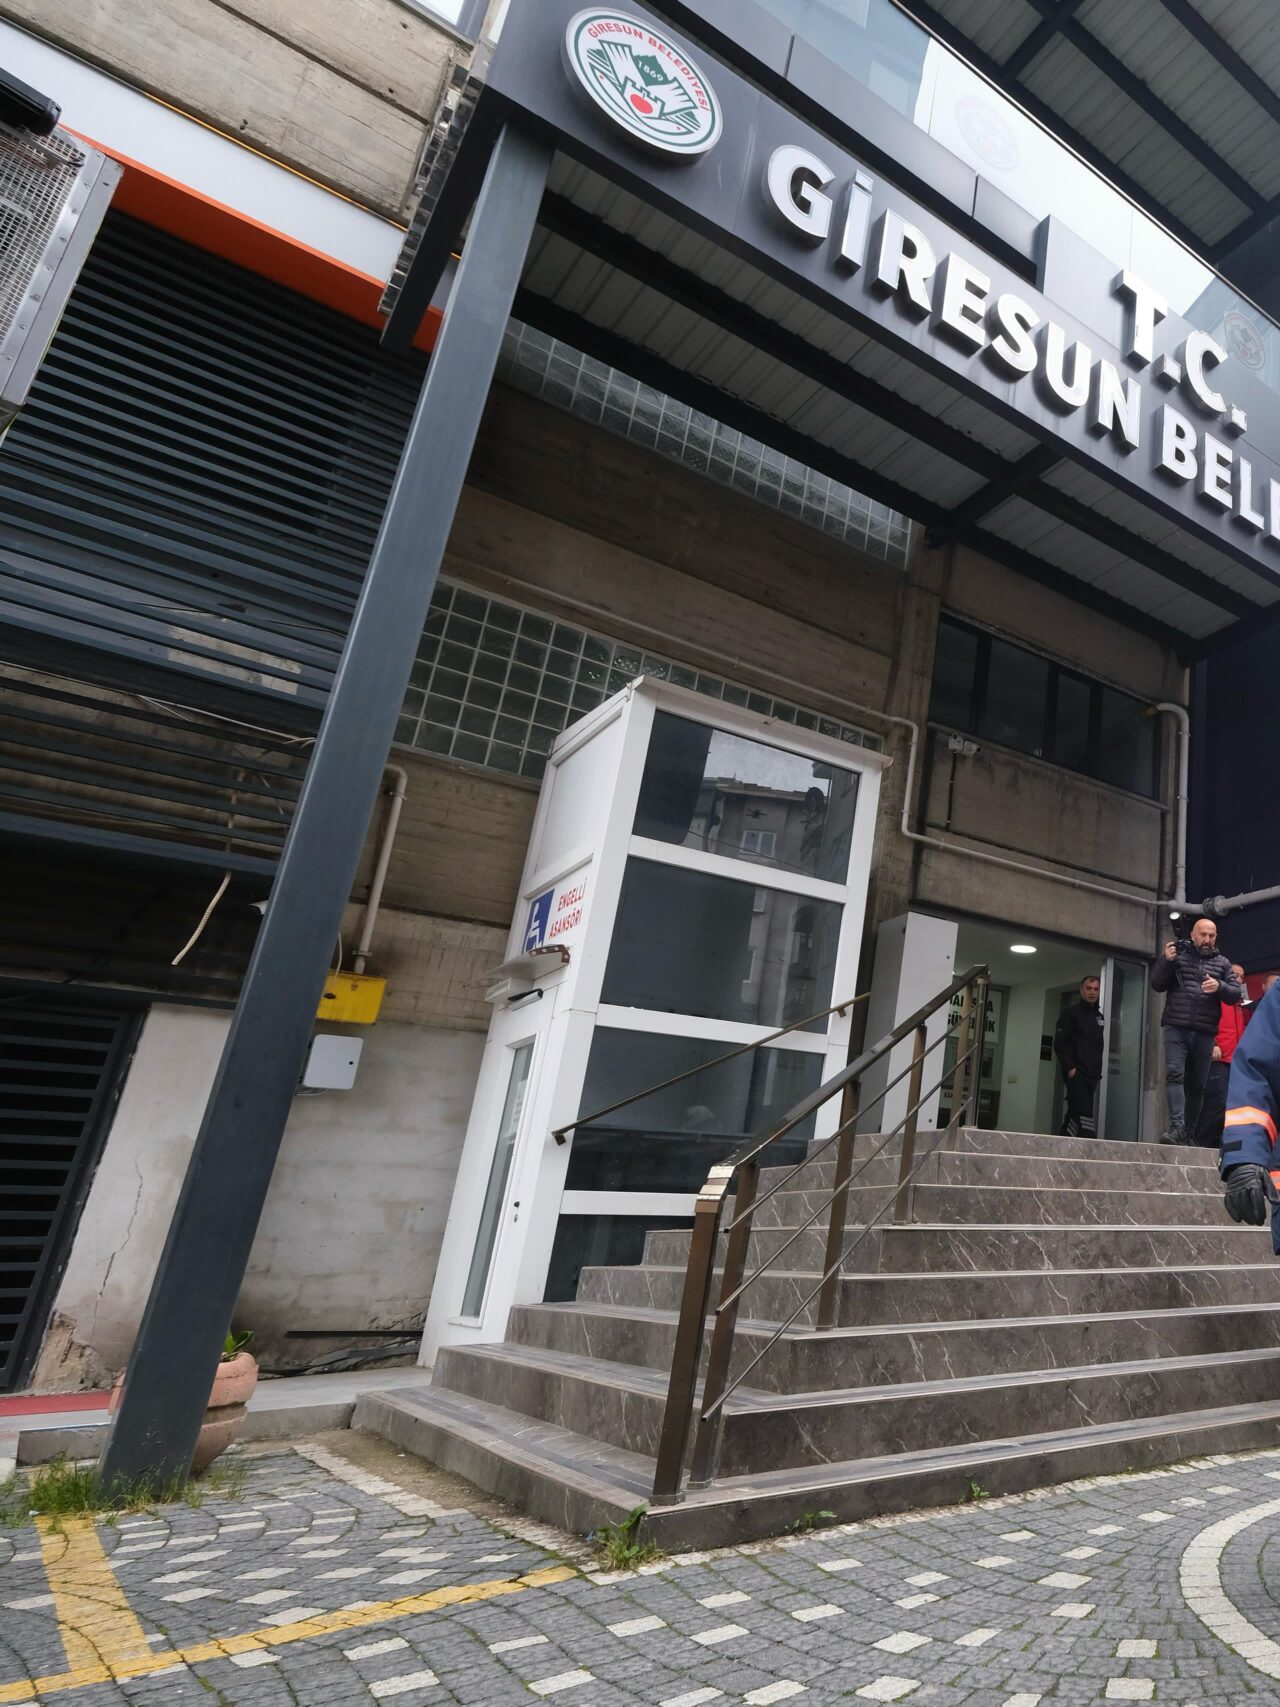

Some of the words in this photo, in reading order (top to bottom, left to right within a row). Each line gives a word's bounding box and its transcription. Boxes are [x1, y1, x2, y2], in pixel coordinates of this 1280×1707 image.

[587, 23, 644, 40] GİRESUN
[637, 60, 664, 82] 1869
[764, 144, 1142, 452] GİRESUN
[1113, 268, 1247, 436] T.C.
[557, 876, 588, 912] ENGELLİ
